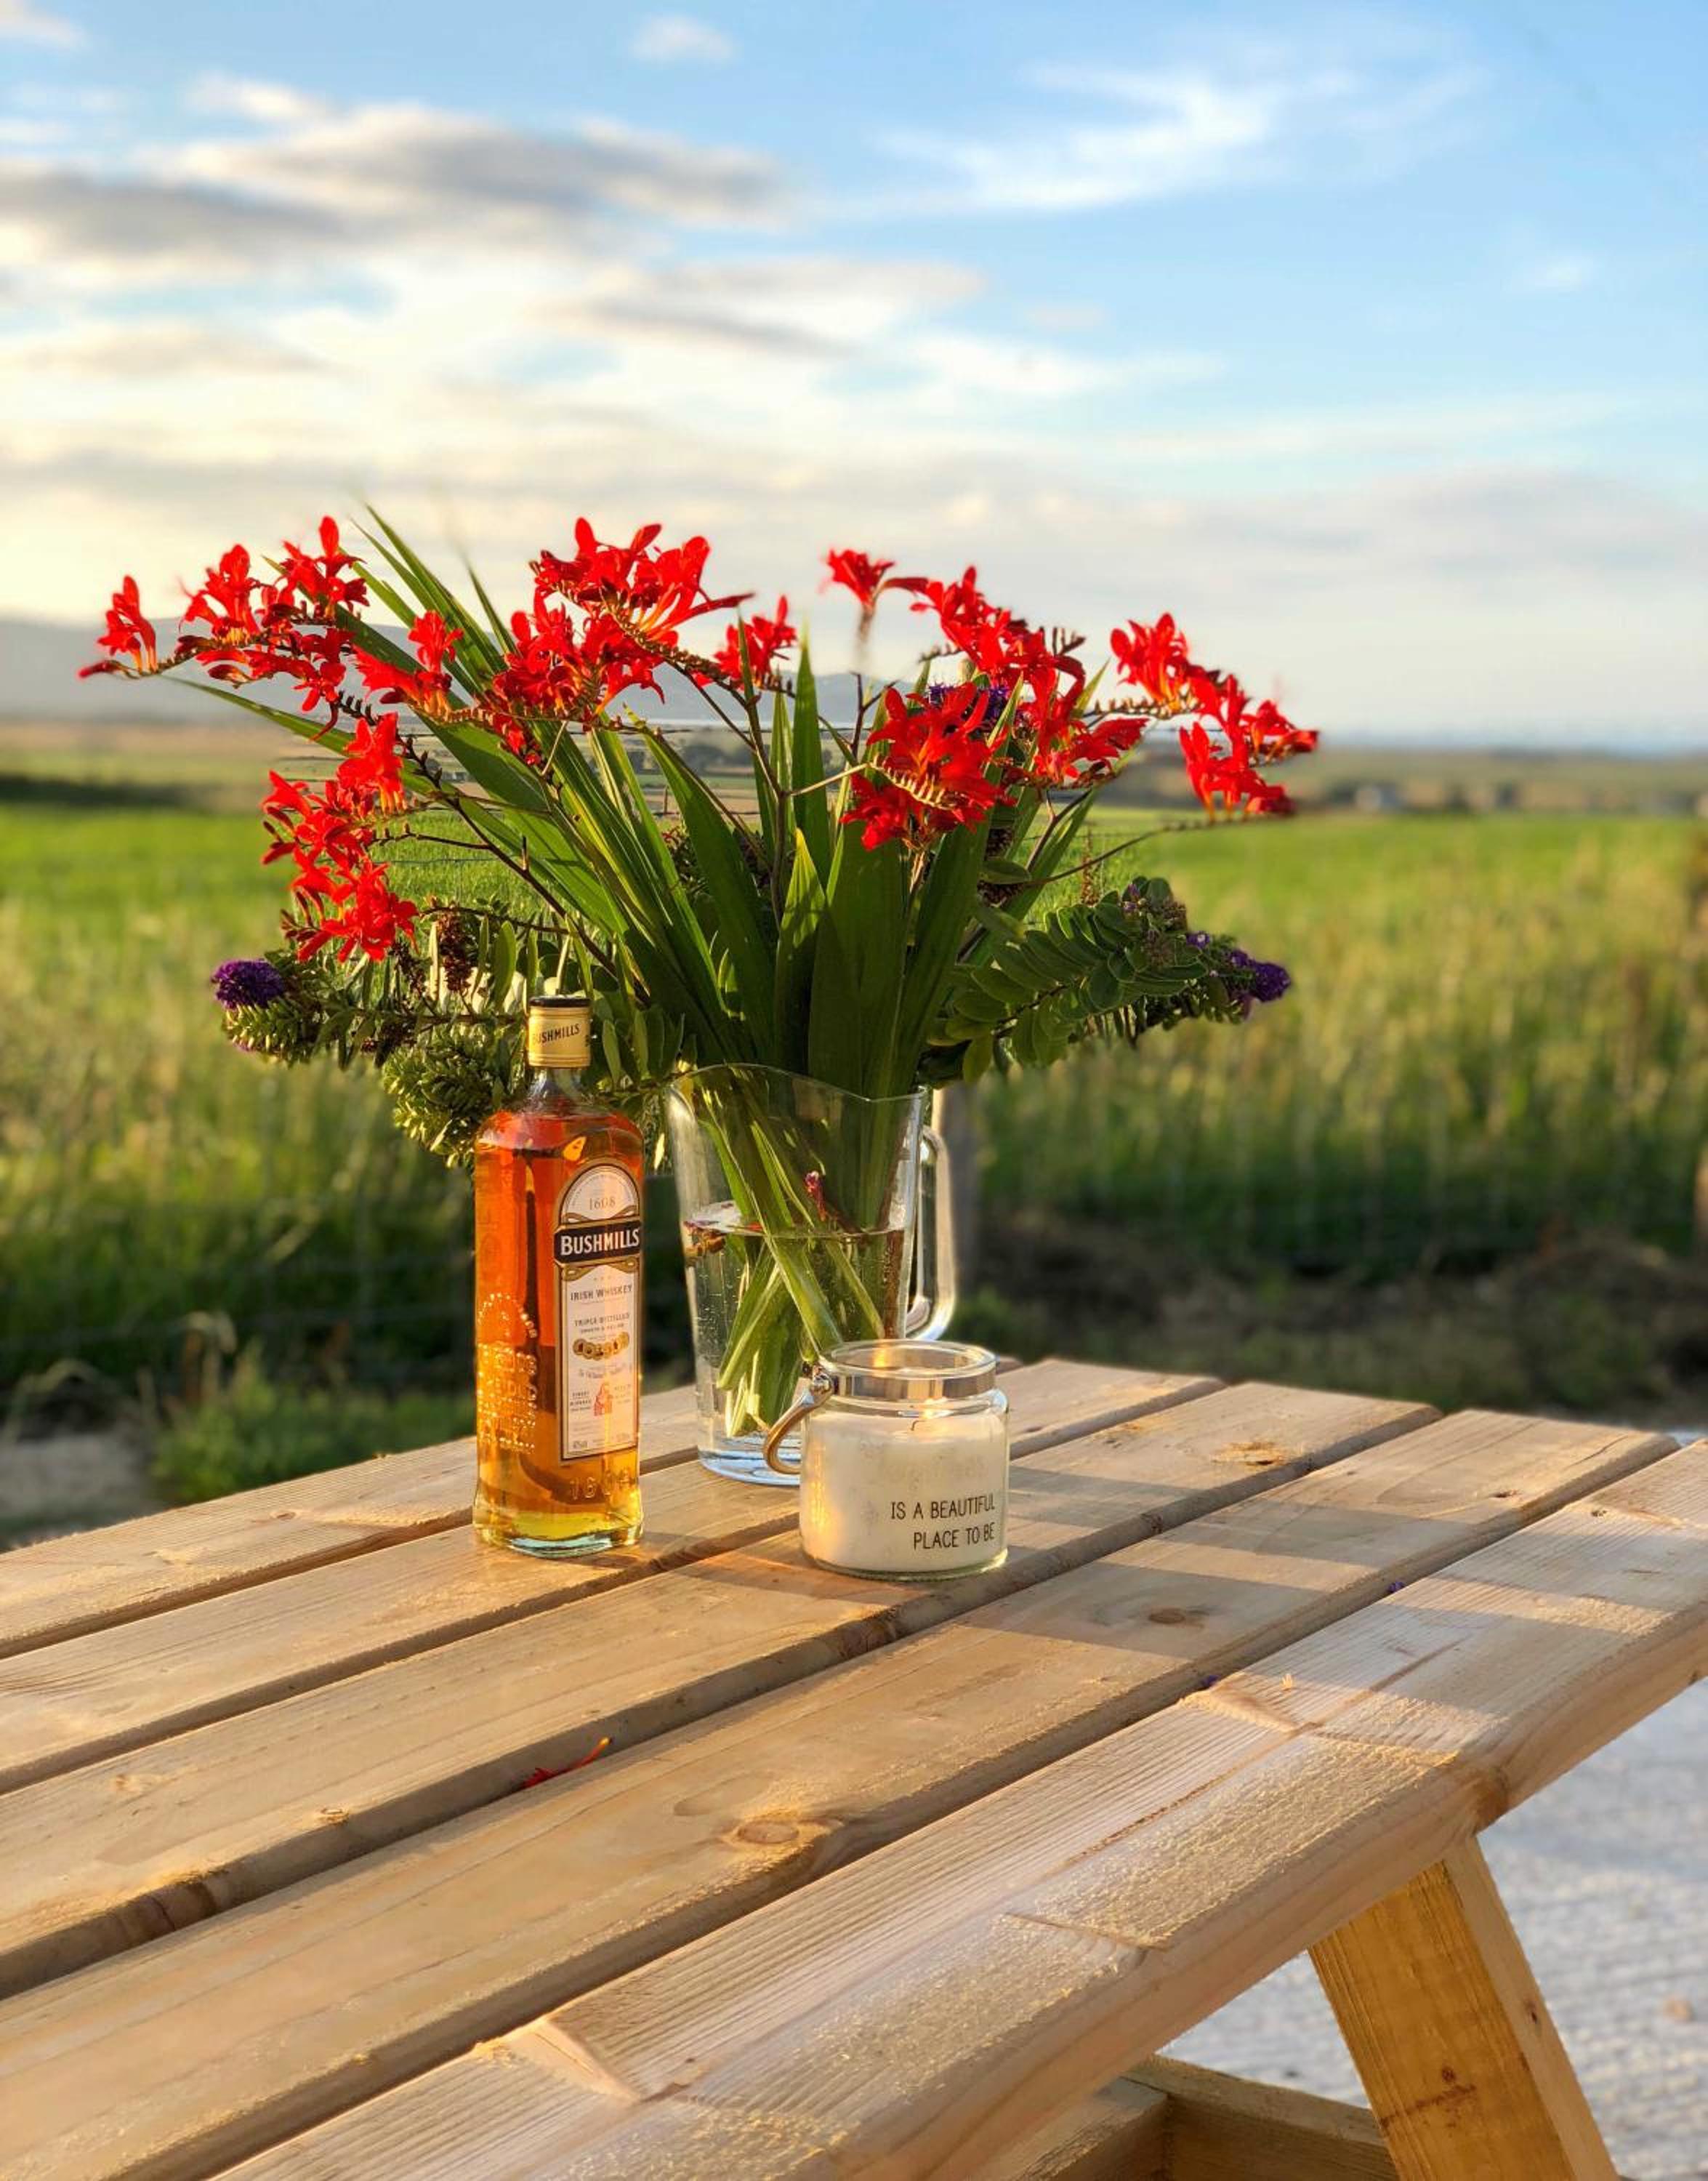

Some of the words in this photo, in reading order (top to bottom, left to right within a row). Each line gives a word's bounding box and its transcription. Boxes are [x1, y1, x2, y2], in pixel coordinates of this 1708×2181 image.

[589, 1197, 616, 1210] 1608
[560, 1229, 640, 1256] BUSHMILLS
[570, 1290, 594, 1301] IRISH
[595, 1284, 632, 1298] WHISKEY
[890, 1501, 906, 1520] IS
[913, 1501, 924, 1519] A
[930, 1493, 995, 1519] BEAUTIFUL
[914, 1529, 960, 1551] PLACE
[965, 1526, 980, 1545] TO
[984, 1522, 995, 1542] BE
